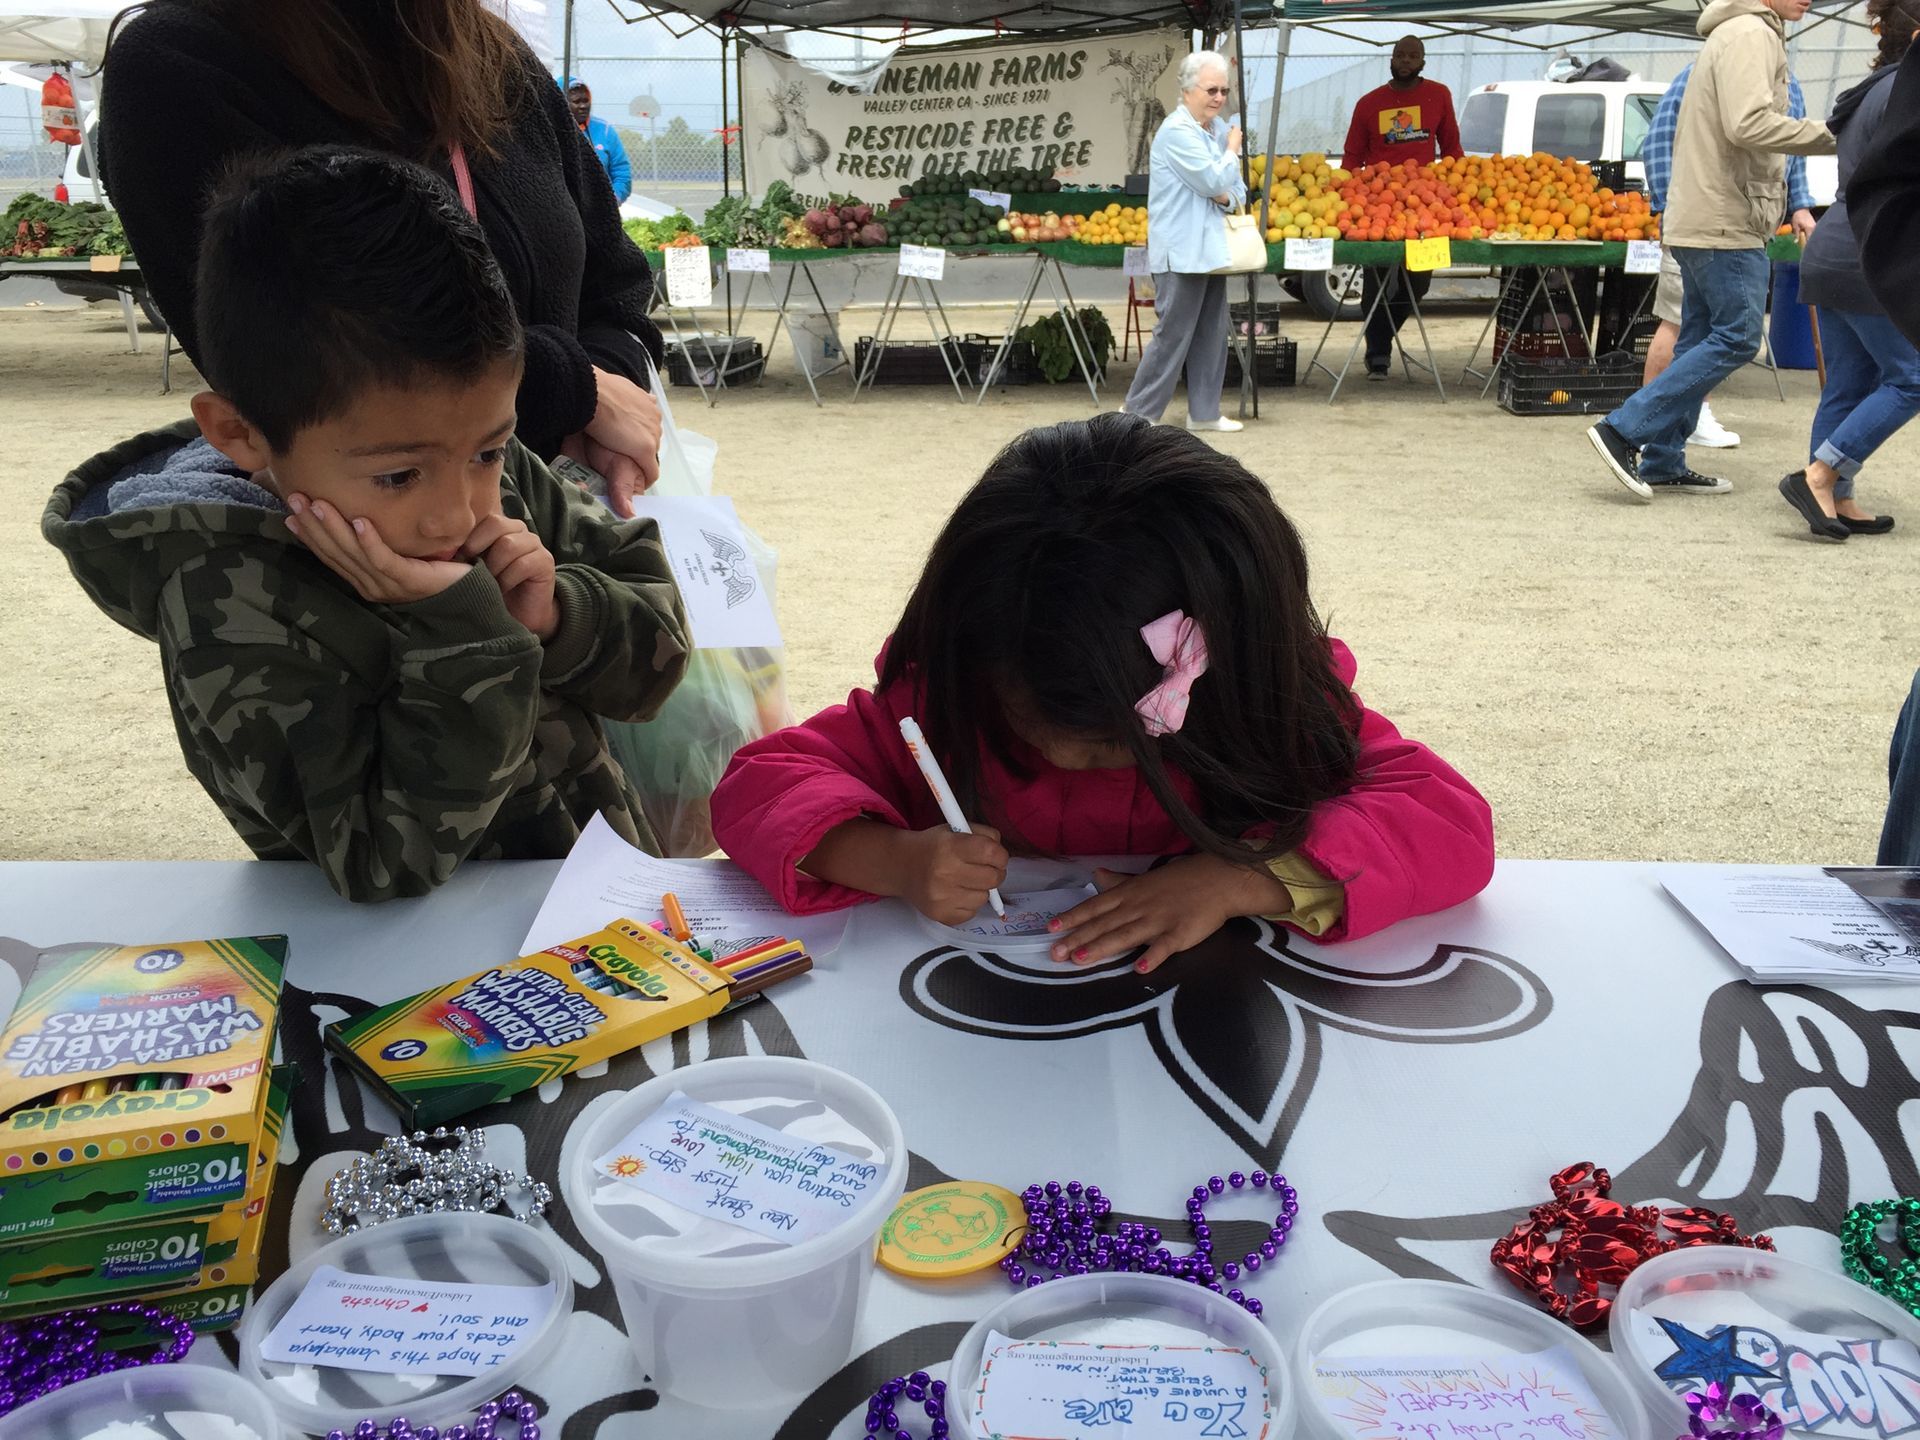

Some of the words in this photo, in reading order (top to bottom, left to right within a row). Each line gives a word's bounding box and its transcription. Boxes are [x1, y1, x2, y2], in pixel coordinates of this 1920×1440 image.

[989, 50, 1087, 88] FARMS
[863, 100, 906, 114] VALLEY
[910, 97, 952, 112] CENTER
[956, 95, 972, 110] CA
[982, 91, 1017, 107] SINCE
[1021, 88, 1050, 103] 1971
[845, 120, 975, 151] PESTICIDE
[982, 114, 1046, 145] FREE
[1053, 111, 1073, 139] &
[836, 152, 913, 179] FRESH
[921, 151, 968, 175] OFF
[976, 146, 1022, 174] THE
[1031, 139, 1092, 170] TREE
[139, 953, 177, 970] 10
[546, 946, 586, 962] NEW!
[587, 944, 670, 996] Crayola
[150, 990, 200, 1002] COLOR
[521, 967, 605, 1025] ULTRA-CLEAN
[45, 996, 232, 1034] MARKERS
[470, 970, 582, 1047] WASHABLE
[446, 1012, 471, 1030] COLOR
[449, 986, 542, 1052] MARKERS
[8, 1012, 260, 1059] WASHABLE
[22, 1038, 229, 1077] ULTRA-CLEAN
[393, 1041, 418, 1061] 10
[197, 1064, 257, 1086] NEW!
[12, 1089, 209, 1131] Crayola
[667, 1118, 696, 1135] for
[699, 1128, 818, 1177] encouragement
[795, 1145, 835, 1172] day!
[148, 1162, 200, 1178] Colors
[203, 1157, 243, 1181] 10
[763, 1163, 792, 1186] you
[840, 1163, 876, 1180] your
[144, 1175, 199, 1192] Classic
[191, 1186, 212, 1195] Most
[214, 1180, 241, 1192] World's
[830, 1172, 867, 1192] and
[156, 1189, 190, 1198] Washable
[797, 1175, 856, 1208] Sending
[29, 1216, 55, 1229] Fine
[760, 1210, 799, 1231] New
[106, 1238, 159, 1253] Colors
[160, 1233, 200, 1259] 10
[101, 1250, 156, 1267] Classic
[169, 1258, 197, 1271] World's
[111, 1264, 147, 1273] Washable
[148, 1263, 170, 1272] Most
[326, 1281, 473, 1303] LidsofEncouragement.org
[162, 1301, 199, 1311] Colo
[202, 1294, 240, 1315] 10
[340, 1295, 410, 1311] Christie
[210, 1312, 238, 1321] World's
[439, 1313, 483, 1326] soul.
[492, 1316, 528, 1328] and
[299, 1324, 352, 1339] heart
[358, 1325, 404, 1343] body,
[412, 1330, 454, 1343] your
[465, 1332, 515, 1346] feeds
[391, 1350, 430, 1366] this
[437, 1342, 480, 1365] hope
[485, 1354, 506, 1365] I
[1006, 1351, 1150, 1366] LidsofEncouragement.org
[1119, 1366, 1185, 1376] BELIEVE
[1155, 1376, 1213, 1386] BELIEVE
[1168, 1387, 1229, 1397] UNIQUE
[1234, 1386, 1247, 1397] A
[1391, 1388, 1539, 1412] AWESOME!
[1389, 1420, 1441, 1439] Are
